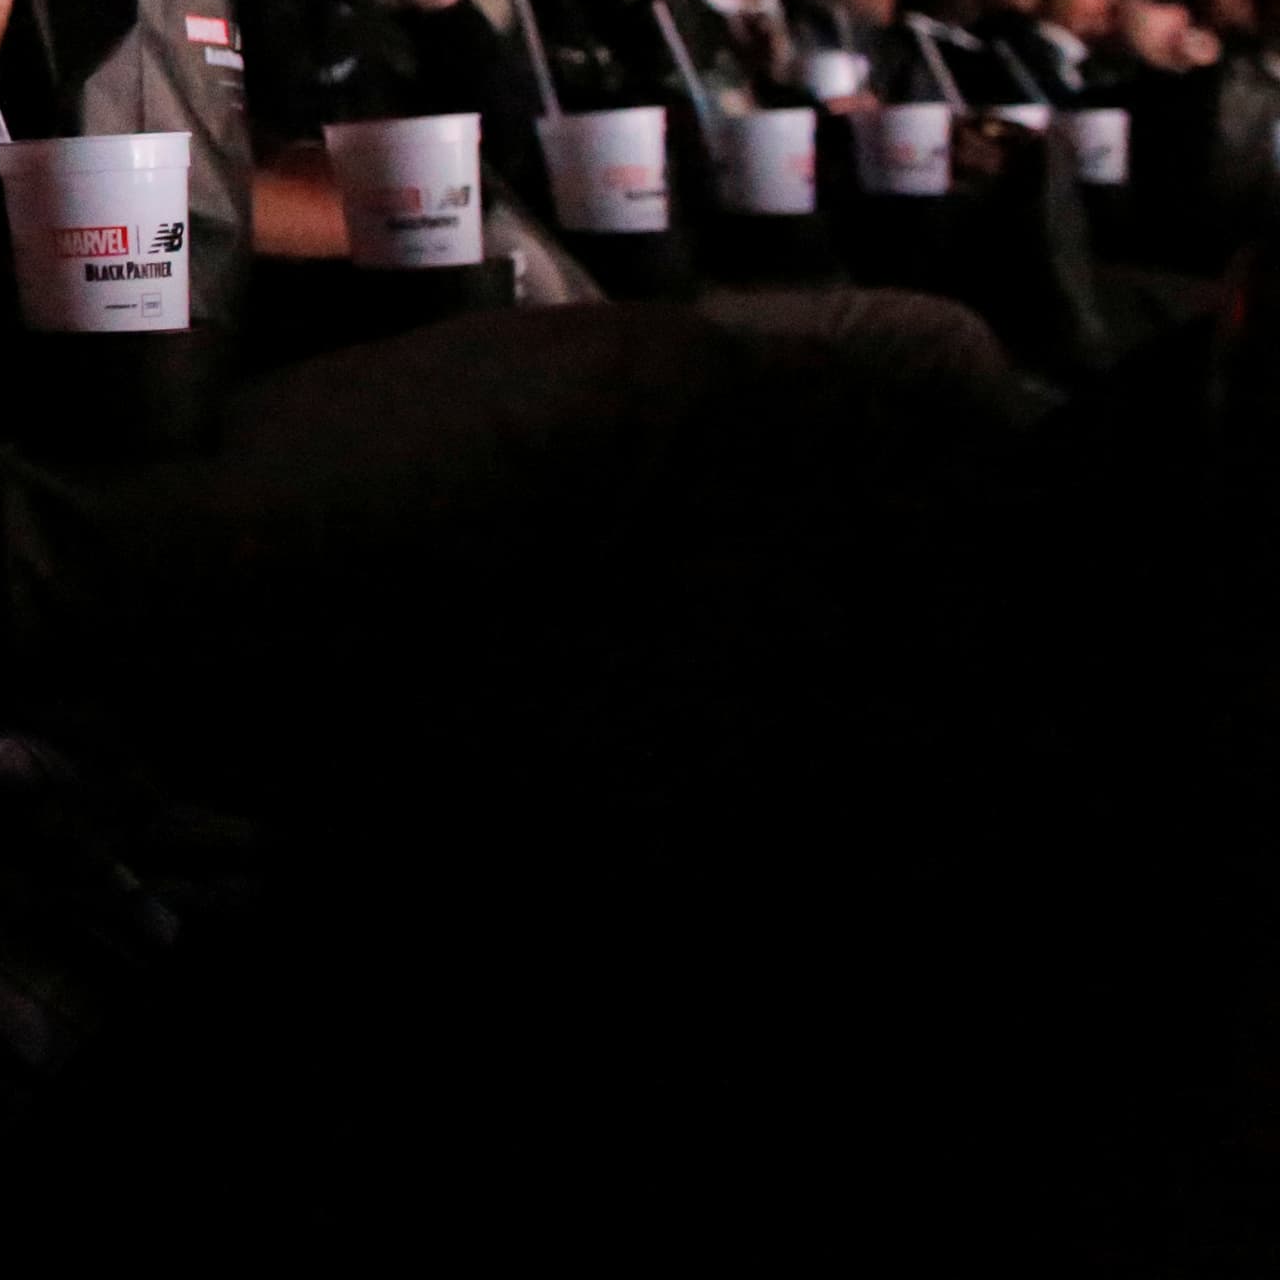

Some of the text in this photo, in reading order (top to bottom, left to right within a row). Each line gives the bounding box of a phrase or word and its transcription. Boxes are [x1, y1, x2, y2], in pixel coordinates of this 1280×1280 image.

[57, 228, 126, 255] MARVEL
[85, 261, 172, 281] BLACK PANTHER
